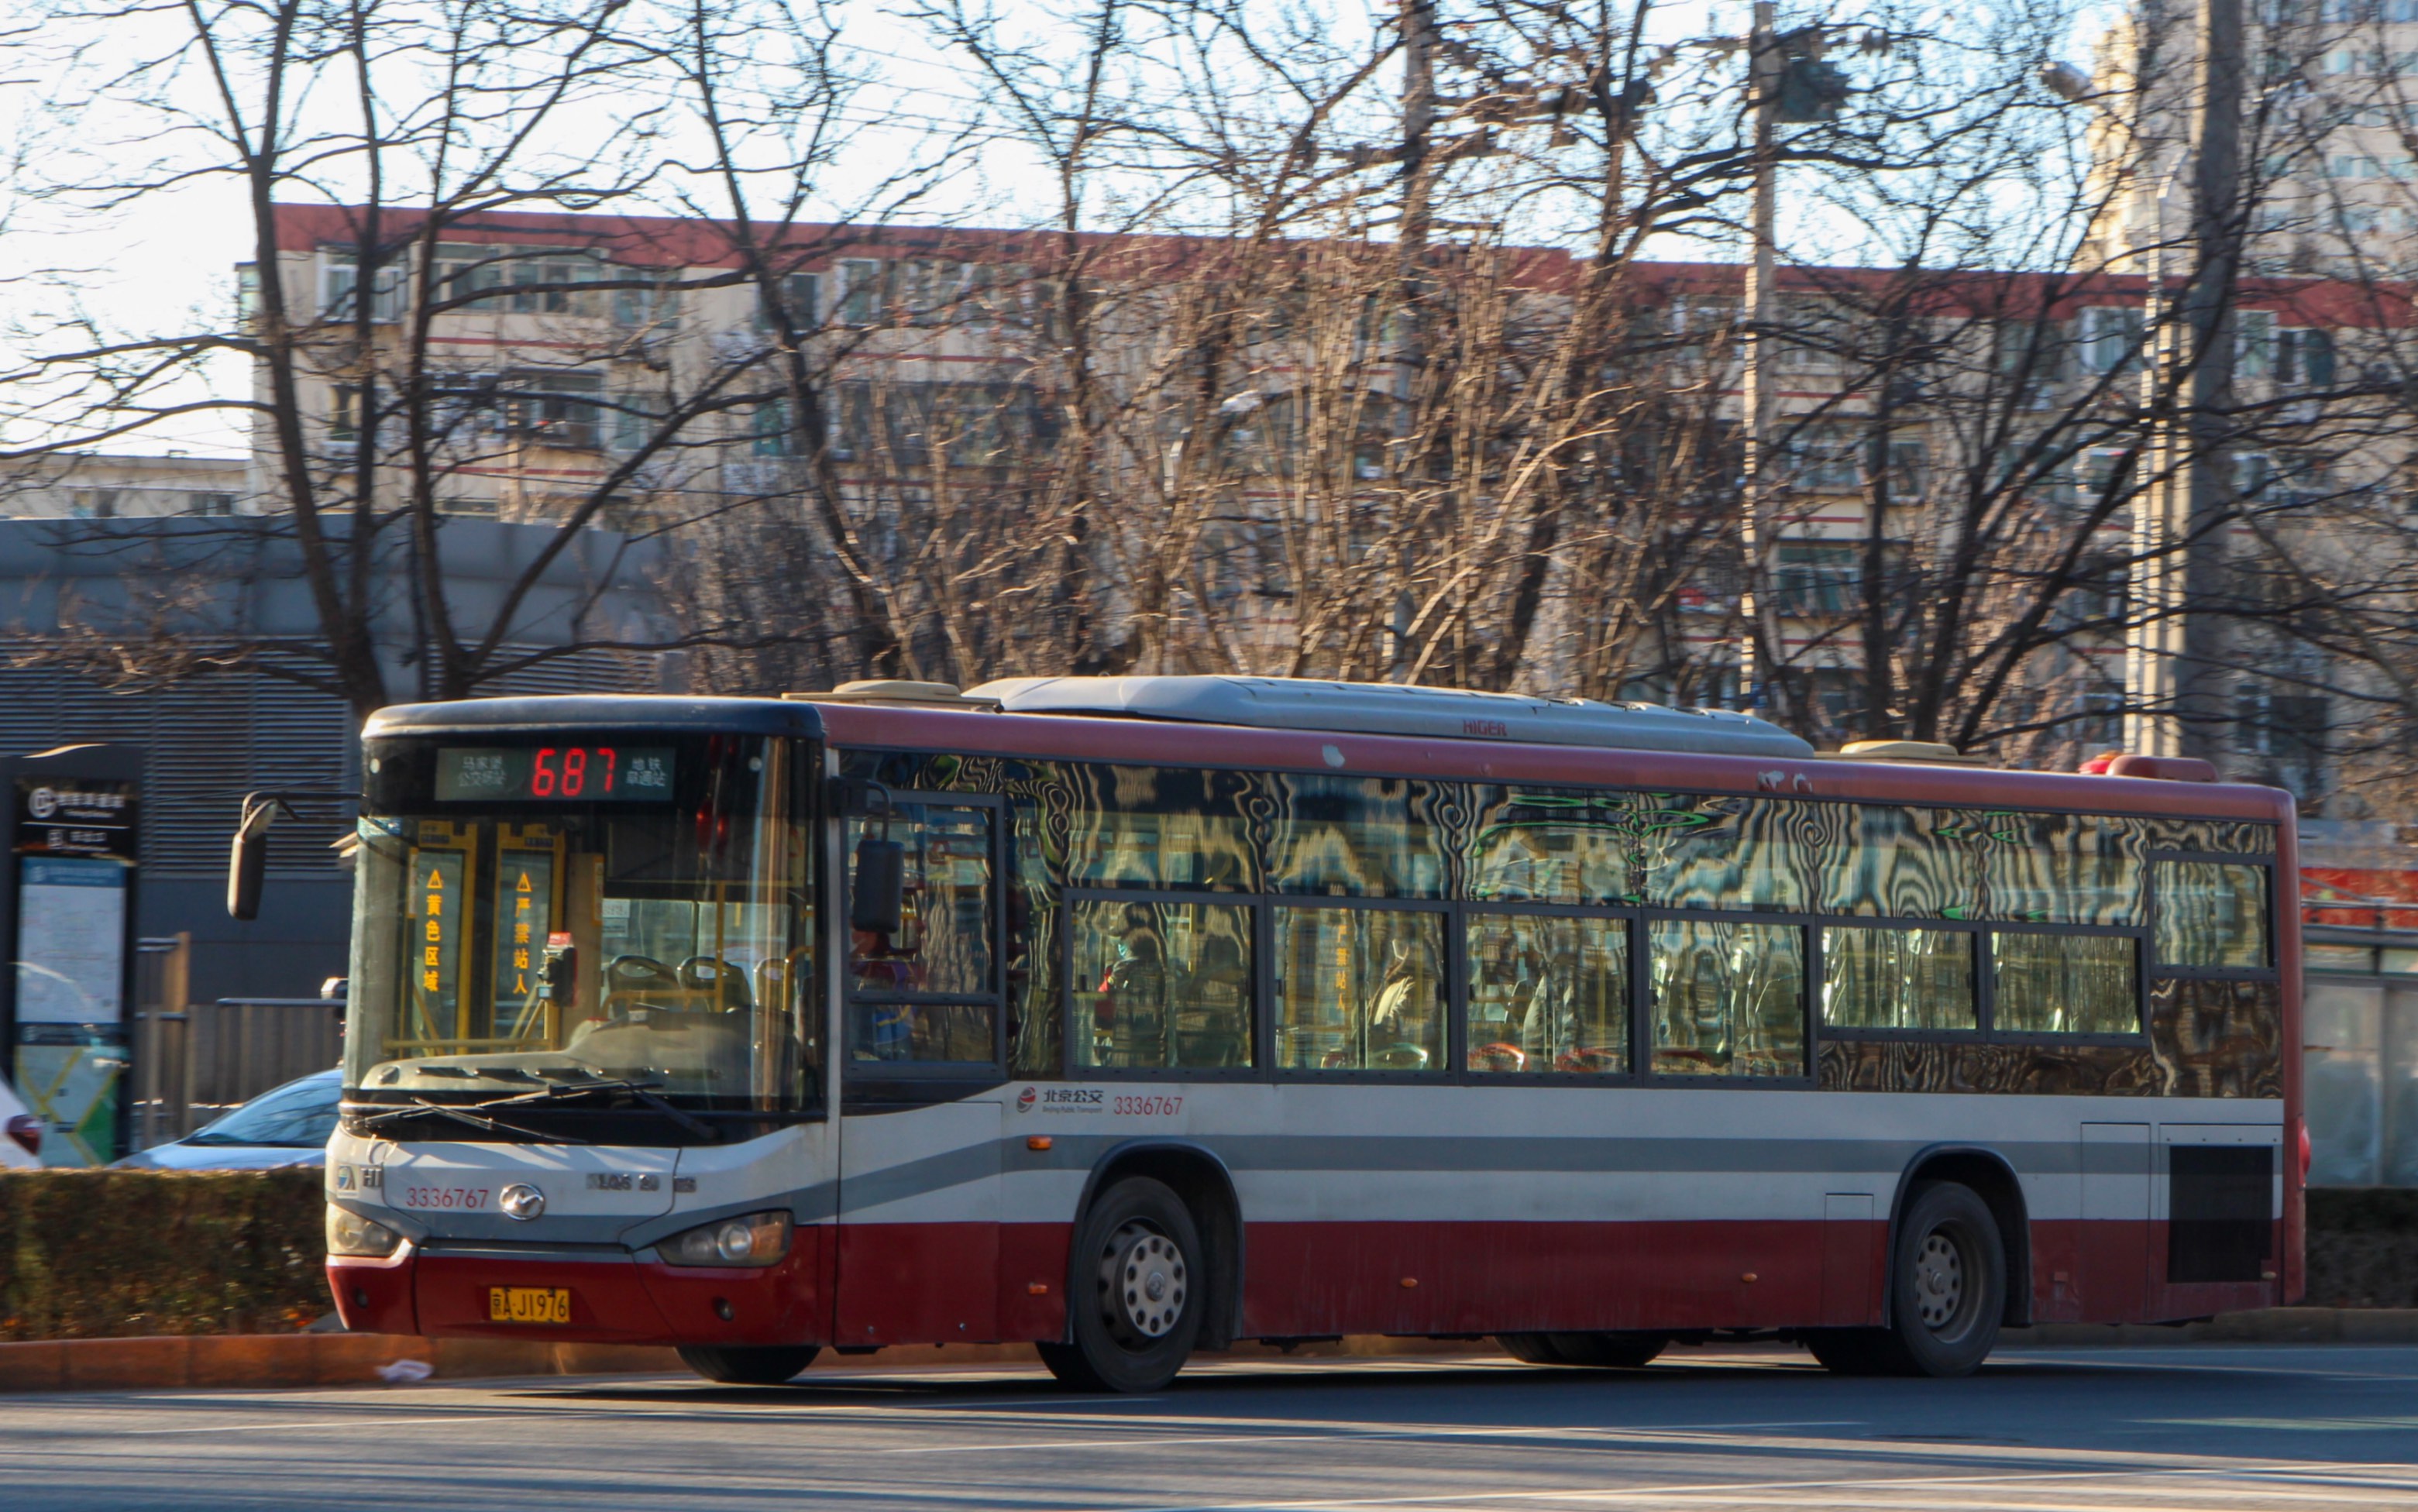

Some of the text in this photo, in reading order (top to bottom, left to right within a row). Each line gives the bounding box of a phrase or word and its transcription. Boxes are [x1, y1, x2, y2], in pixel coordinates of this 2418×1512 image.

[1463, 719, 1508, 737] HIGER
[531, 747, 615, 796] 687
[422, 894, 442, 991] 黄色区域
[513, 897, 531, 994] 严禁站人
[1044, 1089, 1104, 1103] 北京公交
[1113, 1096, 1182, 1115] 3336767
[406, 1187, 490, 1208] 3336767
